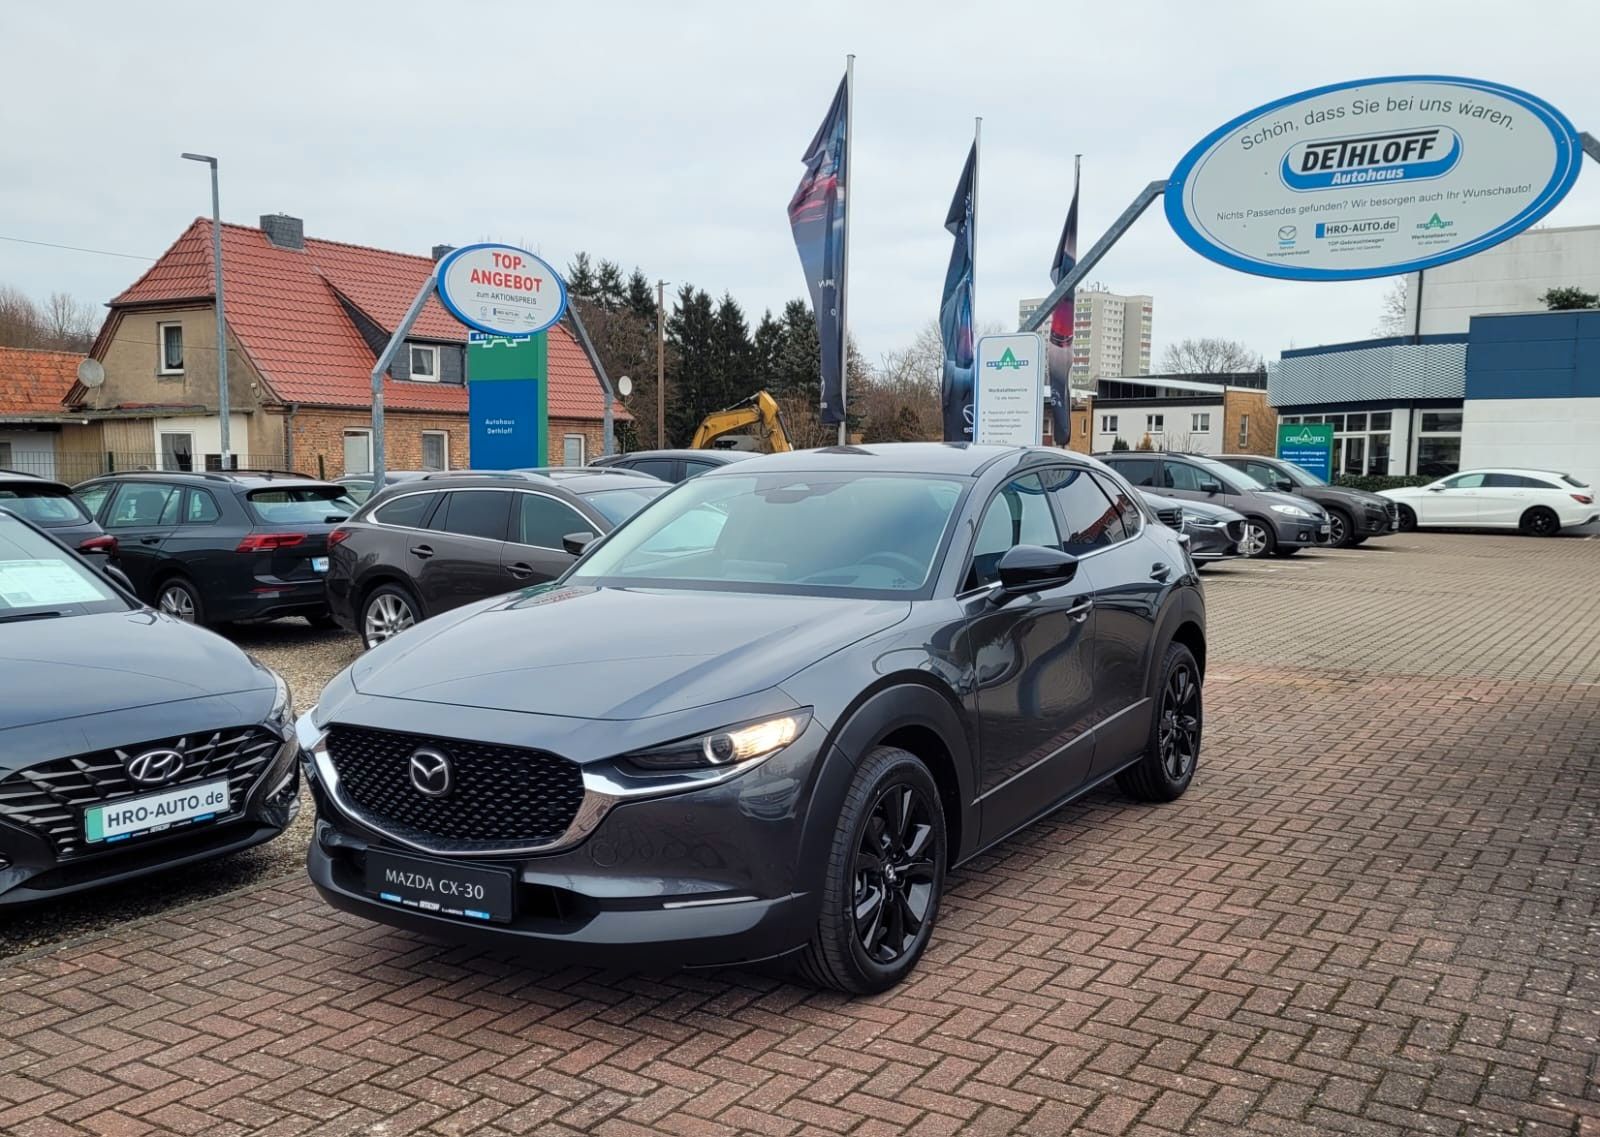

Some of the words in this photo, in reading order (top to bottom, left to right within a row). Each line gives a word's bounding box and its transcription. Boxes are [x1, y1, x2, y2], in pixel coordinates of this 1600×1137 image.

[1241, 121, 1299, 150] Schön,
[1304, 106, 1345, 126] dass
[1352, 99, 1380, 115] Sie
[1386, 96, 1414, 112] bei
[1419, 101, 1452, 112] uns
[1459, 102, 1514, 130] waren.
[1301, 129, 1440, 172] DETHLOFF
[1331, 168, 1404, 185] Autohaus
[1216, 208, 1244, 221] Nichts
[1246, 206, 1296, 218] Passendes
[1299, 202, 1348, 215] gefunden?
[1351, 198, 1368, 208] Wir
[1370, 196, 1416, 208] besorgen
[1418, 193, 1443, 203] auch
[1446, 190, 1460, 200] Ihr
[1462, 184, 1532, 198] Wunschauto!
[1326, 220, 1396, 235] HRO-AUTO.de
[492, 252, 527, 271] TOP-
[470, 268, 543, 293] ANGEBOT
[490, 292, 537, 305] AKTIONSPREIS
[107, 791, 224, 828] HRO-AUTO.de
[385, 868, 435, 891] MAZDA
[439, 879, 484, 899] CX-30
